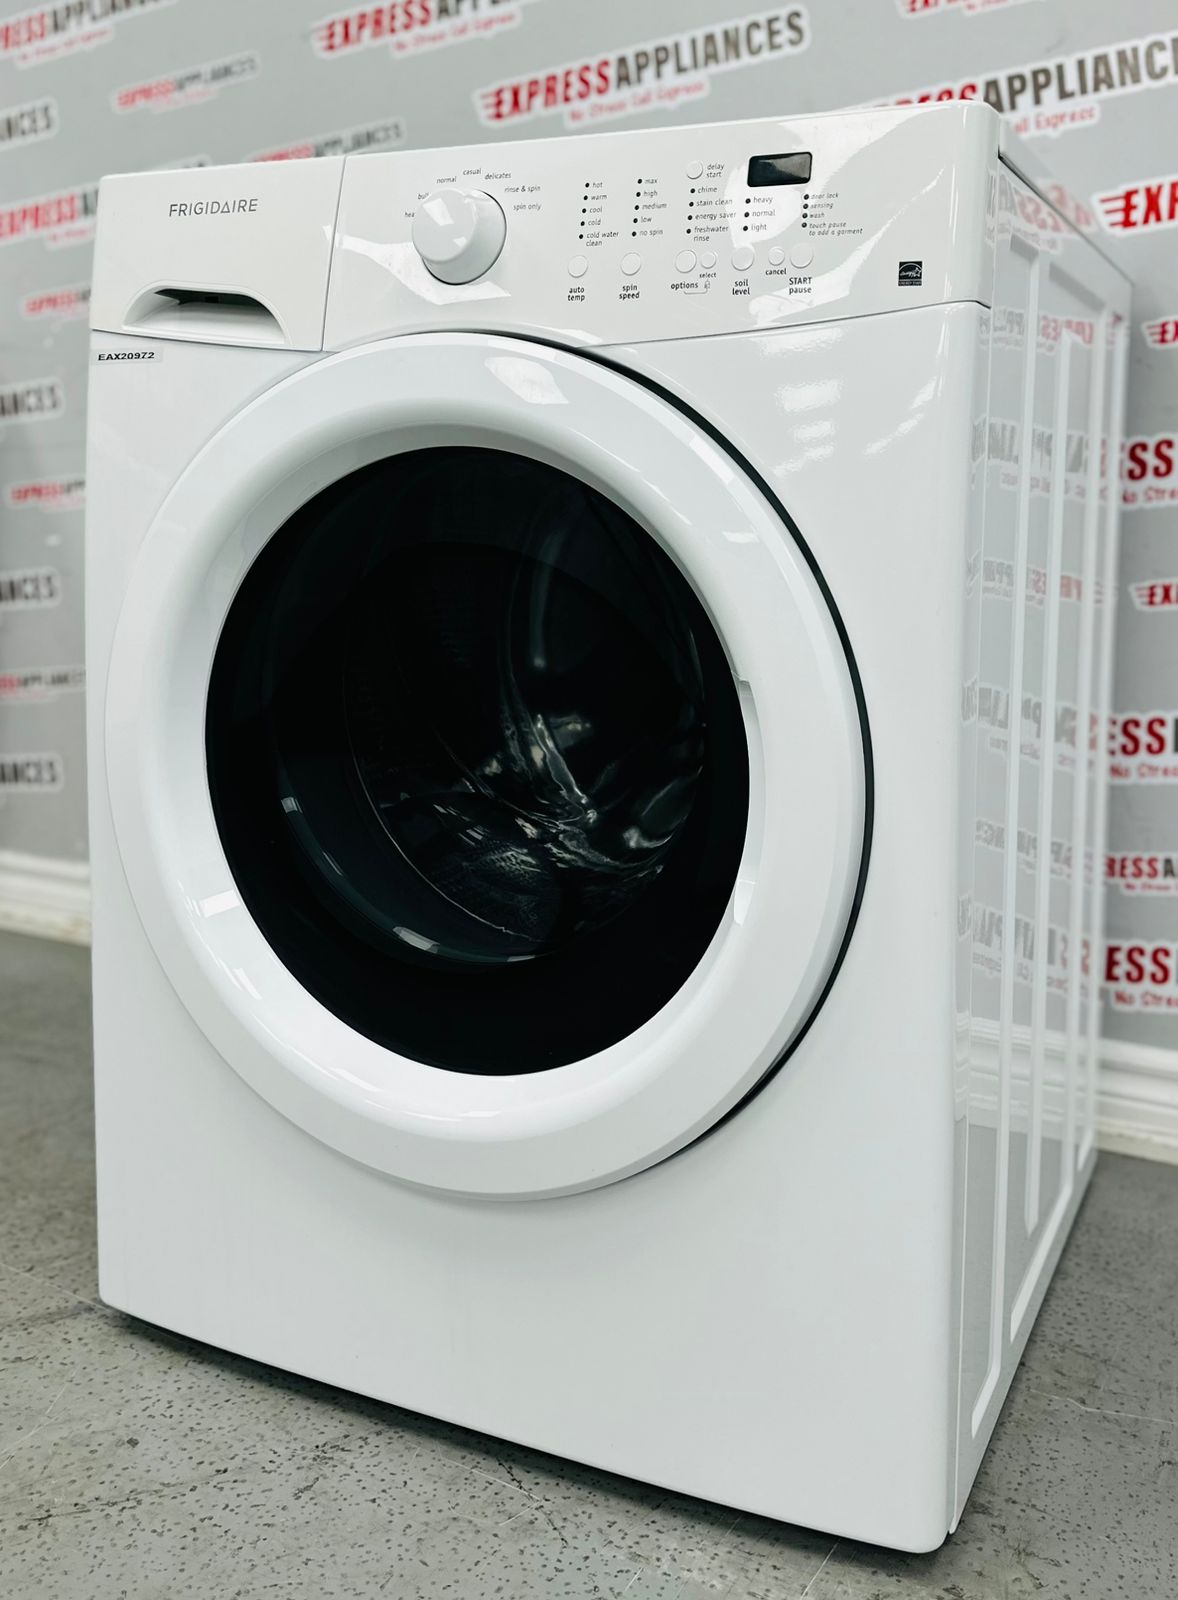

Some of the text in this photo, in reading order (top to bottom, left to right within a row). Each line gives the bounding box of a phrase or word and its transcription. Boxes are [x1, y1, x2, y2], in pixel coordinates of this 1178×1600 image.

[706, 163, 725, 171] delay
[462, 168, 482, 176] casual
[484, 172, 512, 180] delicates
[436, 176, 457, 184] normal
[643, 190, 658, 198] high
[697, 186, 718, 194] chime
[696, 199, 713, 207] stain
[752, 196, 774, 204] heavy
[168, 198, 259, 217] FRIGIDAIRE
[527, 203, 542, 211] only
[694, 211, 737, 221] energy saver
[587, 218, 602, 226] cold
[808, 222, 847, 230] touch pause
[693, 225, 729, 233] freshwater
[750, 223, 767, 232] light
[586, 231, 600, 239] cold
[649, 229, 664, 237] spin
[837, 228, 863, 237] garment
[764, 268, 787, 276] cancel
[733, 278, 749, 287] soil
[788, 276, 813, 286] START
[622, 283, 638, 293] spin
[670, 281, 699, 291] options
[732, 286, 751, 296] level
[788, 287, 812, 296] pause
[567, 294, 586, 302] temp
[618, 291, 641, 301] speed
[97, 351, 155, 361] EAX20972
